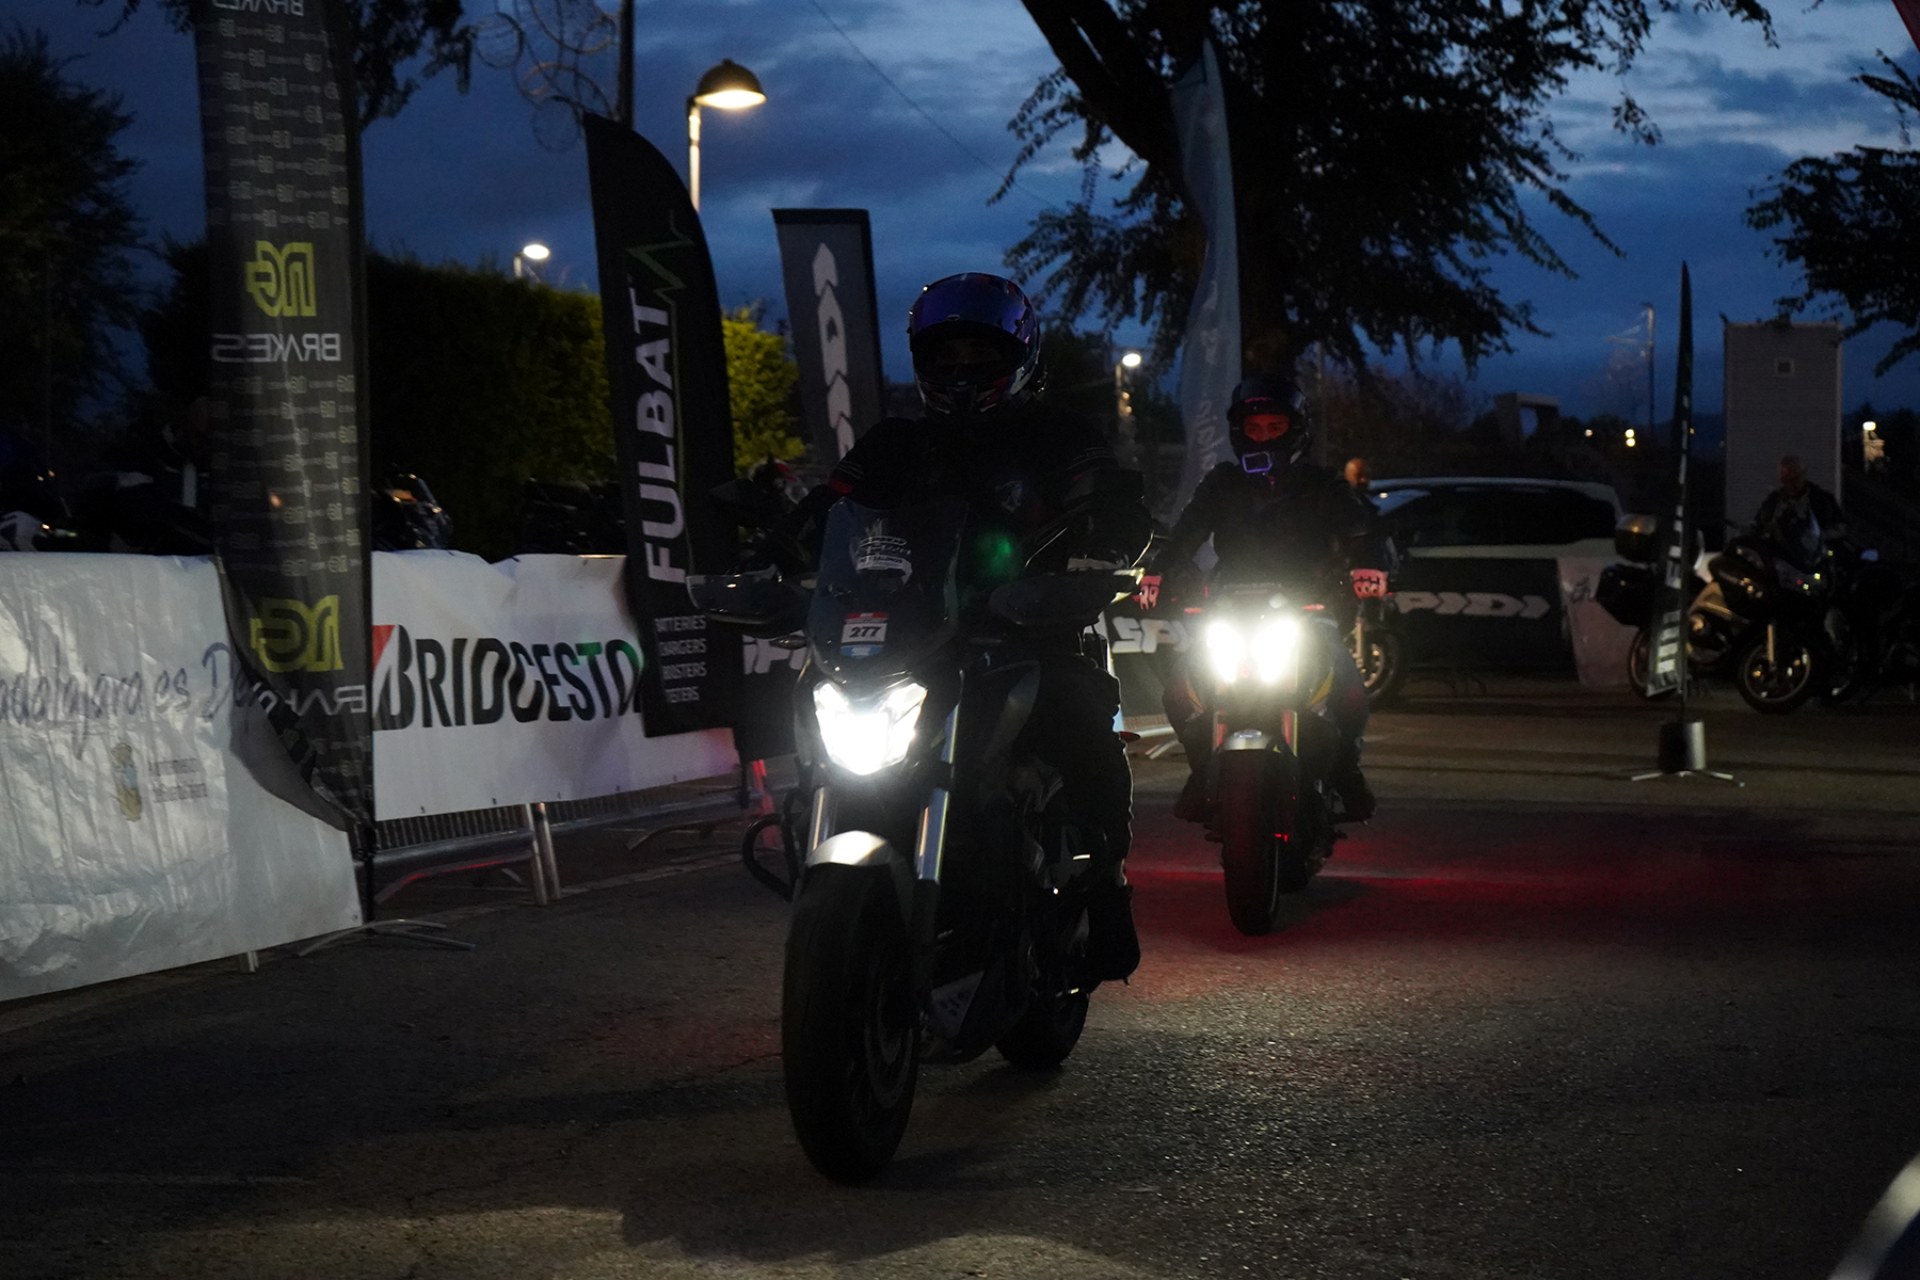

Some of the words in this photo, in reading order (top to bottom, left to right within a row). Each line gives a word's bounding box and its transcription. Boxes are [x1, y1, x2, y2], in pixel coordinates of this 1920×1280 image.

[627, 276, 687, 584] FULBAT
[849, 626, 882, 639] 277
[154, 667, 192, 713] es
[370, 624, 641, 732] BRIDGESTO
